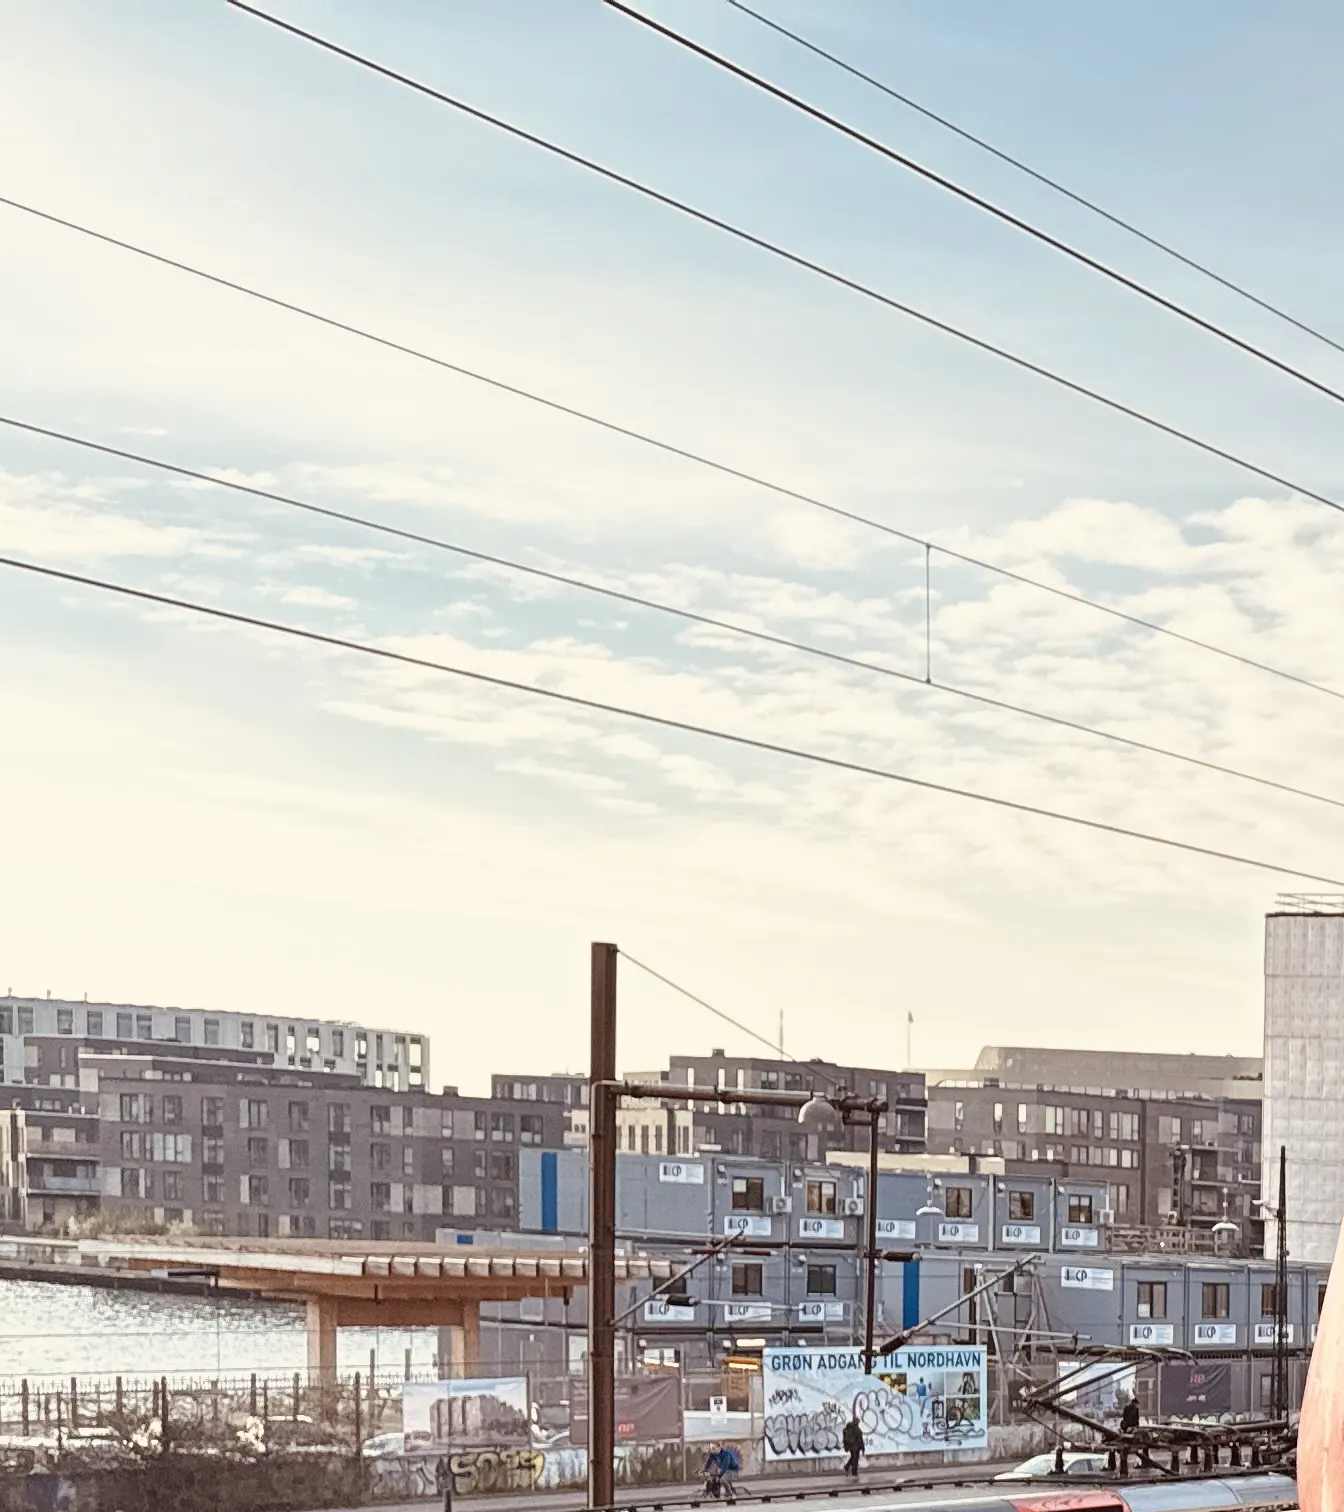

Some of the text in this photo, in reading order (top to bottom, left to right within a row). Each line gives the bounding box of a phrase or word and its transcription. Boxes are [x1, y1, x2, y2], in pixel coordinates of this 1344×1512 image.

[771, 1355, 813, 1371] GRØN
[883, 1353, 903, 1368] TIL
[907, 1352, 981, 1368] NORDHAVN
